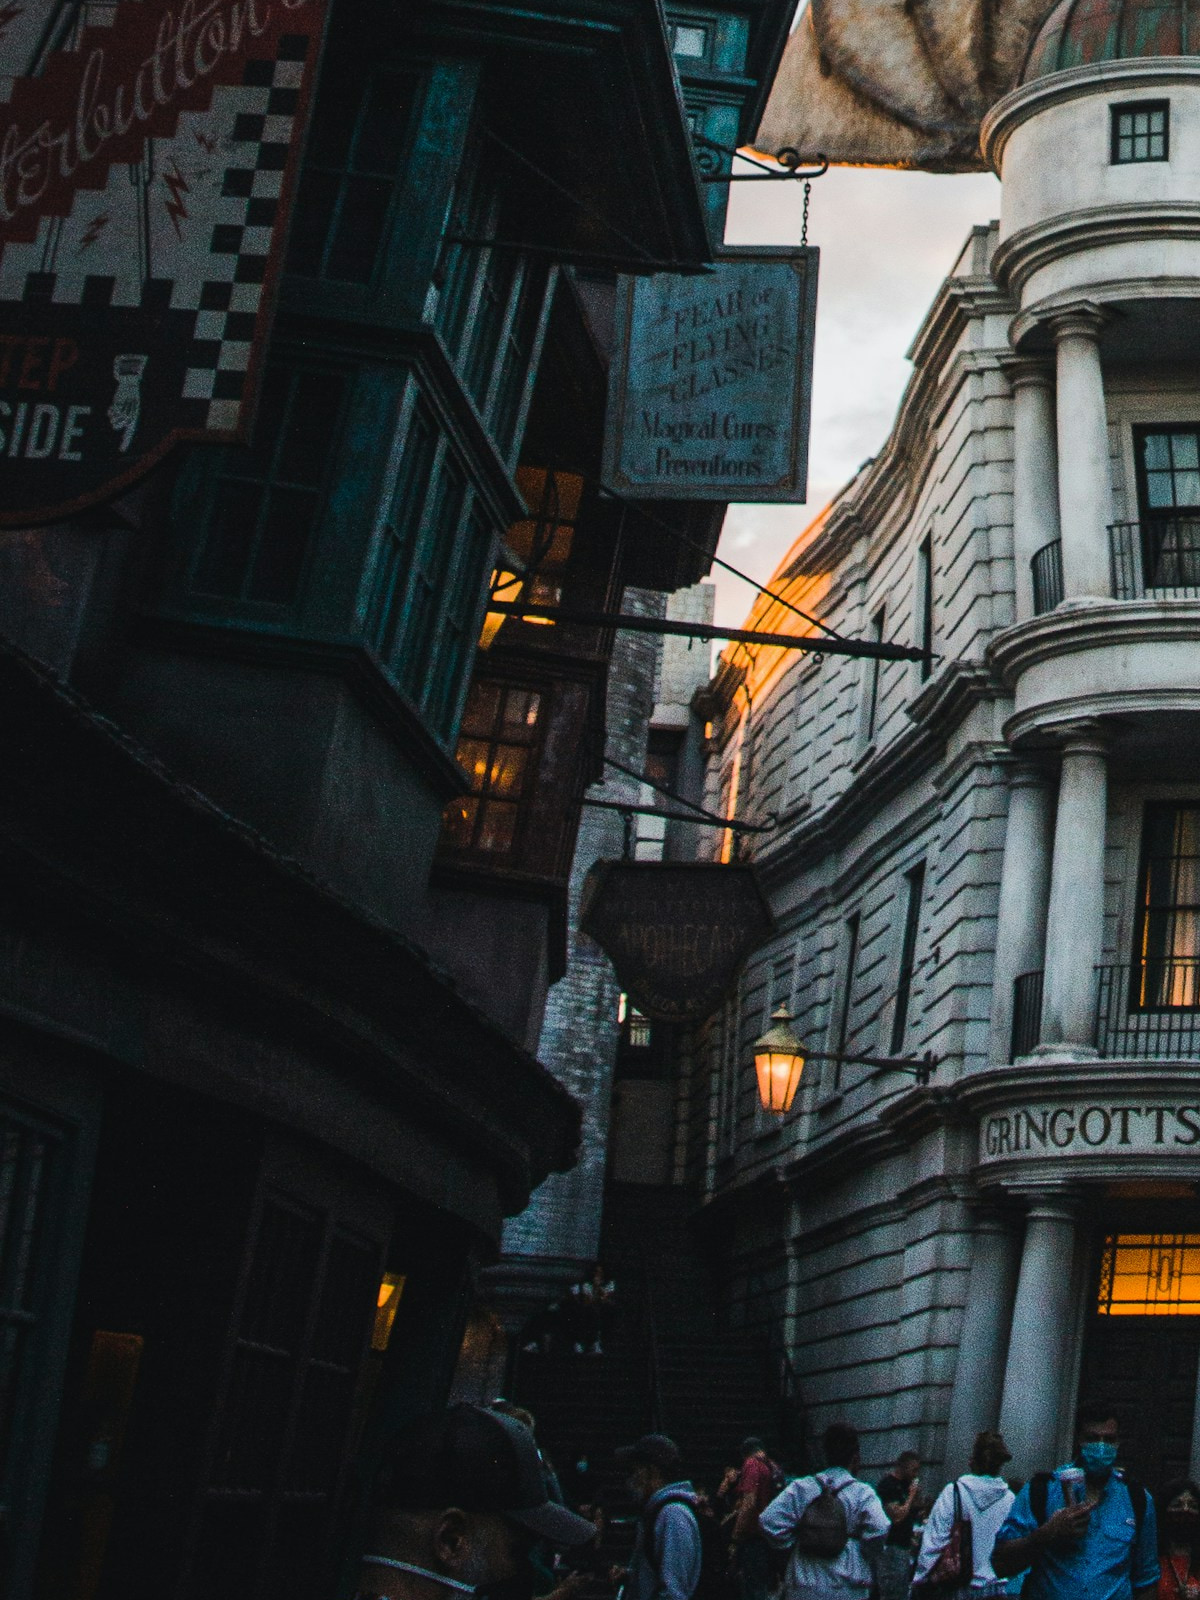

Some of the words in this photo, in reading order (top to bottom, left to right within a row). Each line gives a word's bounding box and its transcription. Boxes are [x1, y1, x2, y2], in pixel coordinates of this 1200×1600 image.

[673, 289, 745, 335] FEAR
[672, 313, 770, 370] FLYING
[669, 341, 791, 403] CLASSES
[641, 410, 717, 444] Magical
[722, 412, 776, 440] Cures
[656, 446, 762, 476] Preventions
